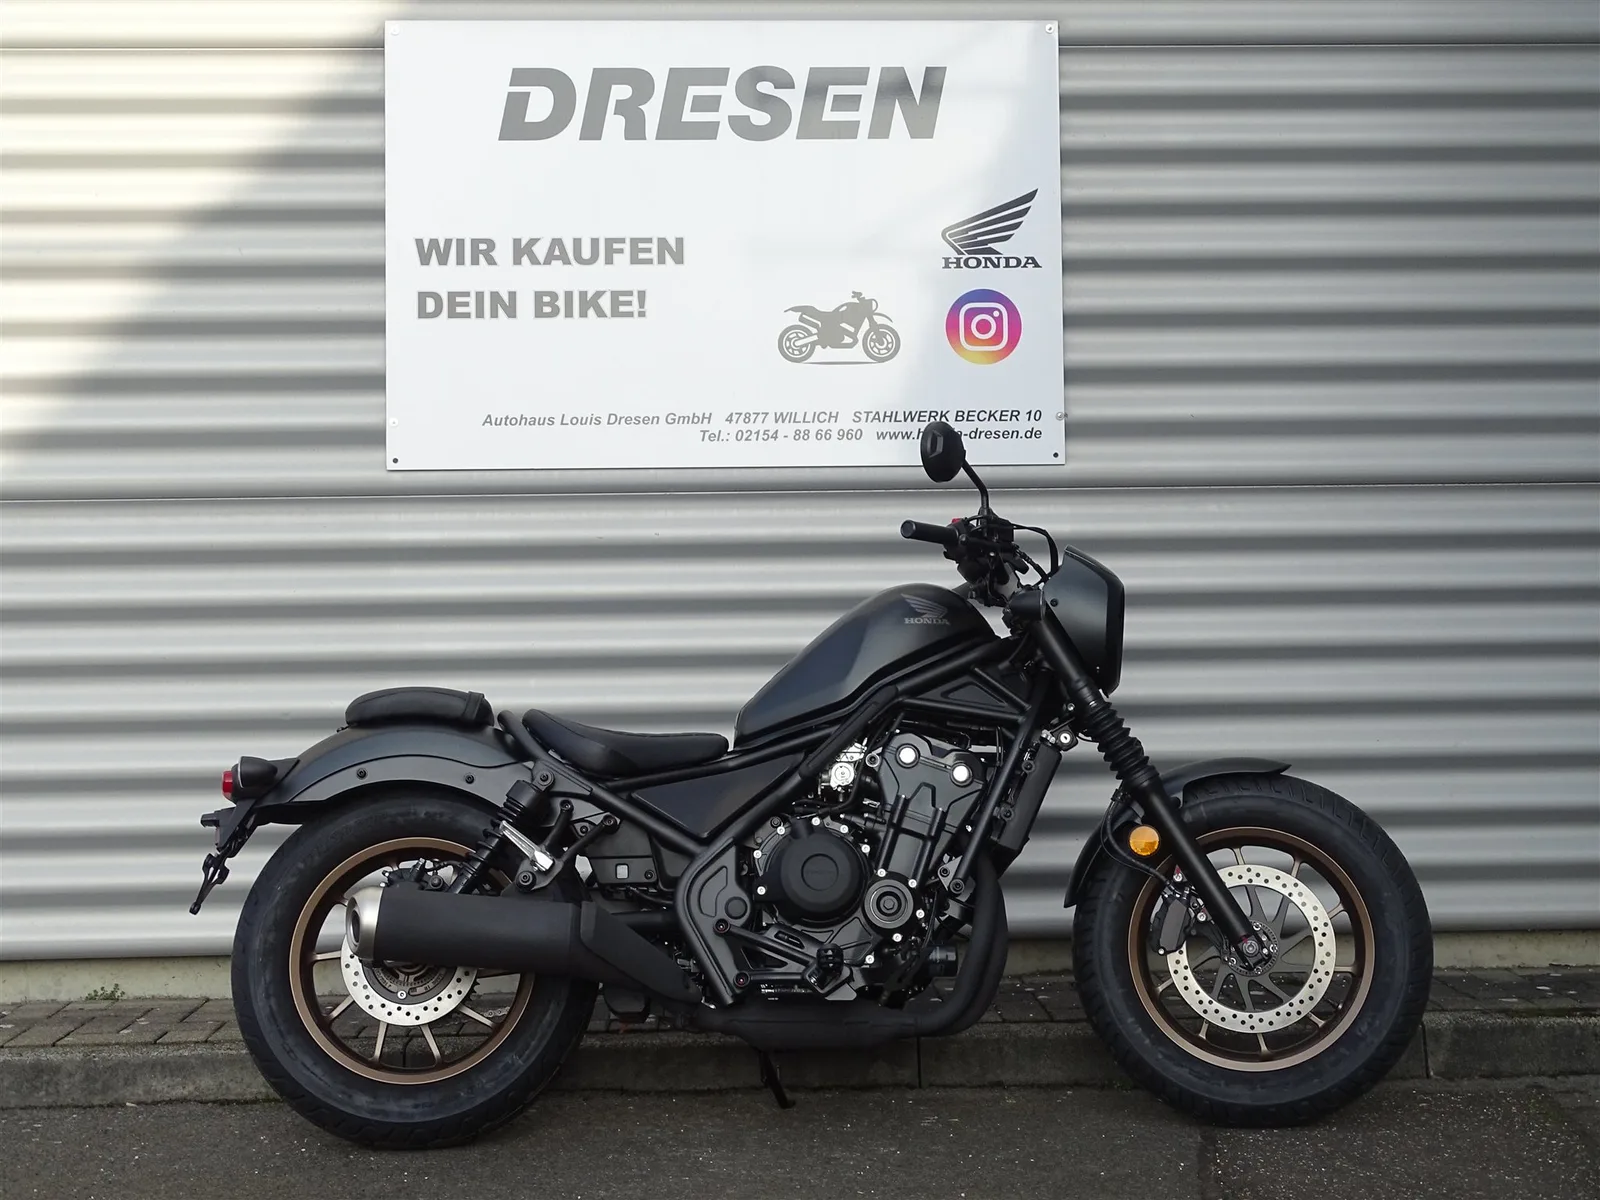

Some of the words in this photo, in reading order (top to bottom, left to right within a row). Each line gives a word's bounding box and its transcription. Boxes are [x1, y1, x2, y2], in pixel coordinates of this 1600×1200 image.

[498, 66, 948, 142] DRESEN
[414, 237, 498, 267] WIR
[512, 236, 685, 266] KAUFEN
[941, 256, 1043, 270] HONDA
[417, 290, 518, 320] DEIN
[533, 290, 647, 319] BIKE!
[481, 413, 556, 427] Autohaus
[559, 413, 602, 426] Louis
[606, 412, 661, 426] Dresen
[664, 412, 713, 426] GmbH
[724, 411, 770, 425] 47877
[774, 411, 840, 424] WILLICH
[852, 410, 951, 424] STAHLWERK
[954, 409, 1021, 423] BECKER
[1025, 409, 1043, 422] 10
[700, 429, 732, 442] Tel.:
[734, 429, 779, 442] 02154
[793, 428, 811, 442] 88
[814, 428, 833, 441] 66
[837, 428, 864, 441] 960
[904, 617, 950, 625] HONDA
